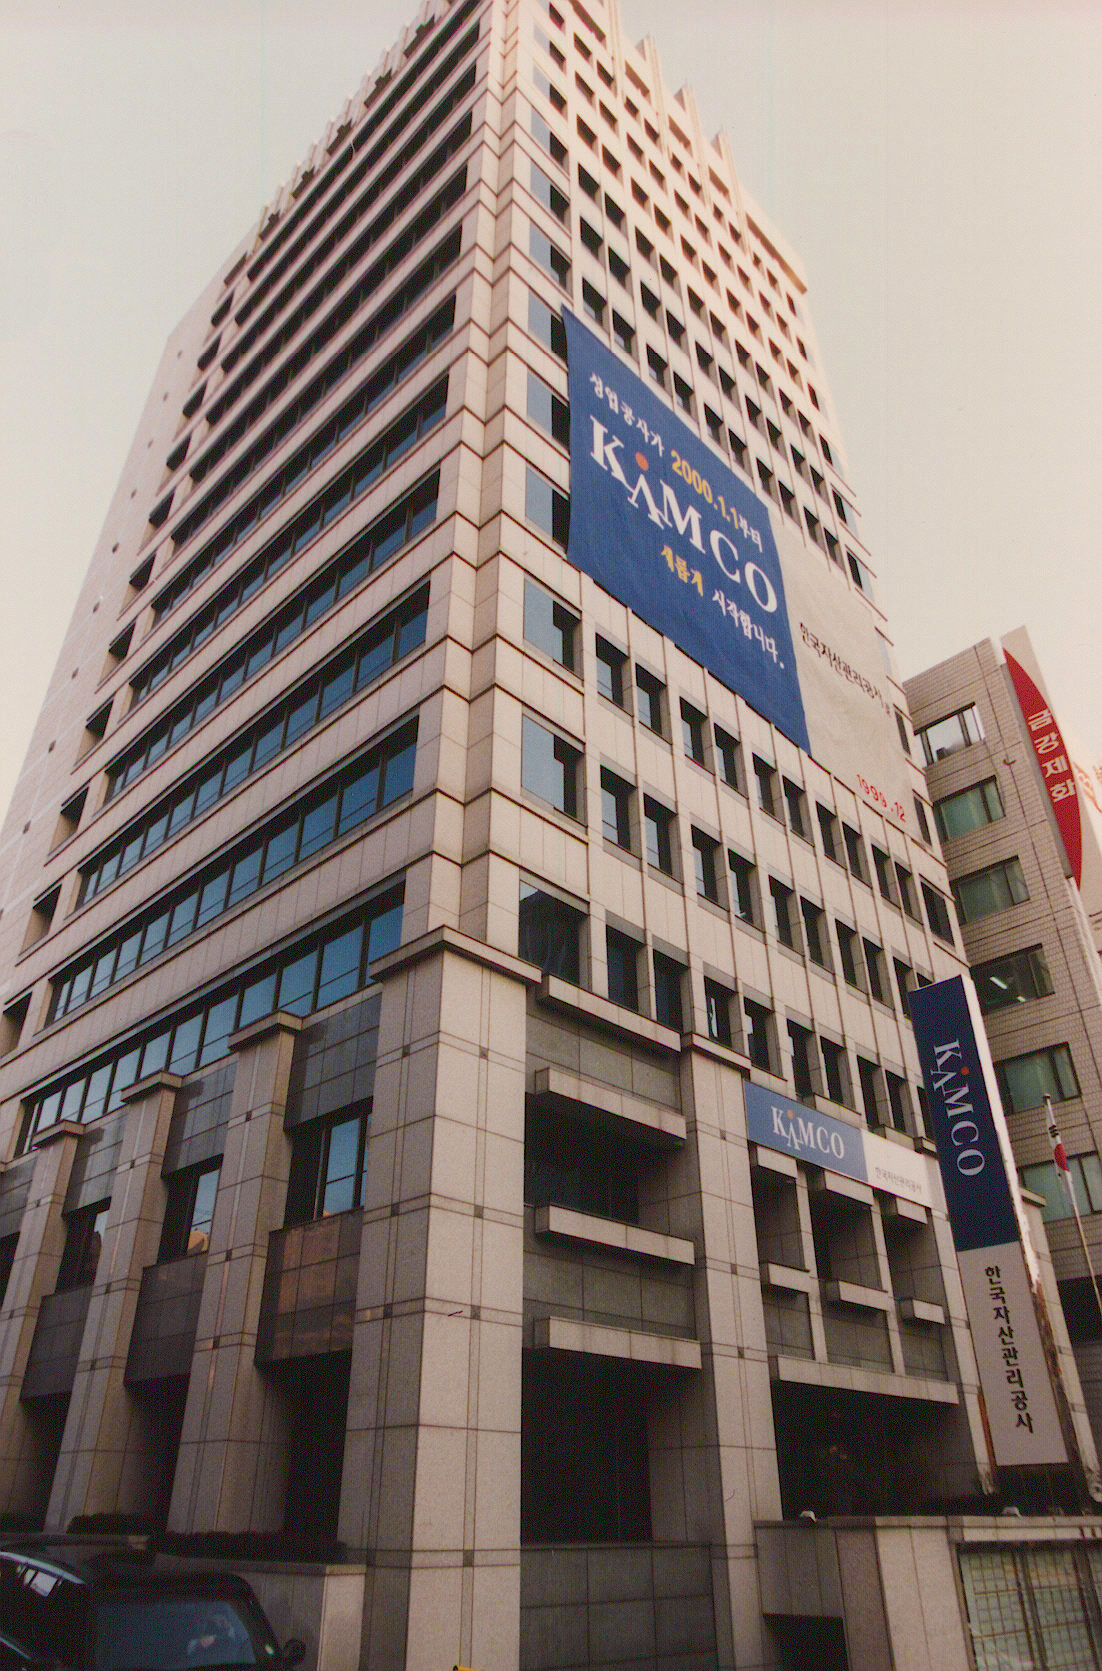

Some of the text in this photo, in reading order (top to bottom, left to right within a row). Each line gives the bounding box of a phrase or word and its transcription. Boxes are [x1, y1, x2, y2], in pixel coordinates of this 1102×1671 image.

[589, 414, 778, 613] KAMCO
[712, 588, 785, 669] 시작합니다.
[1027, 707, 1076, 803] 금강제화
[770, 1105, 845, 1160] KAMCO
[930, 1038, 986, 1177] KAMCO
[984, 1265, 1035, 1434] 한국자산관리공사
